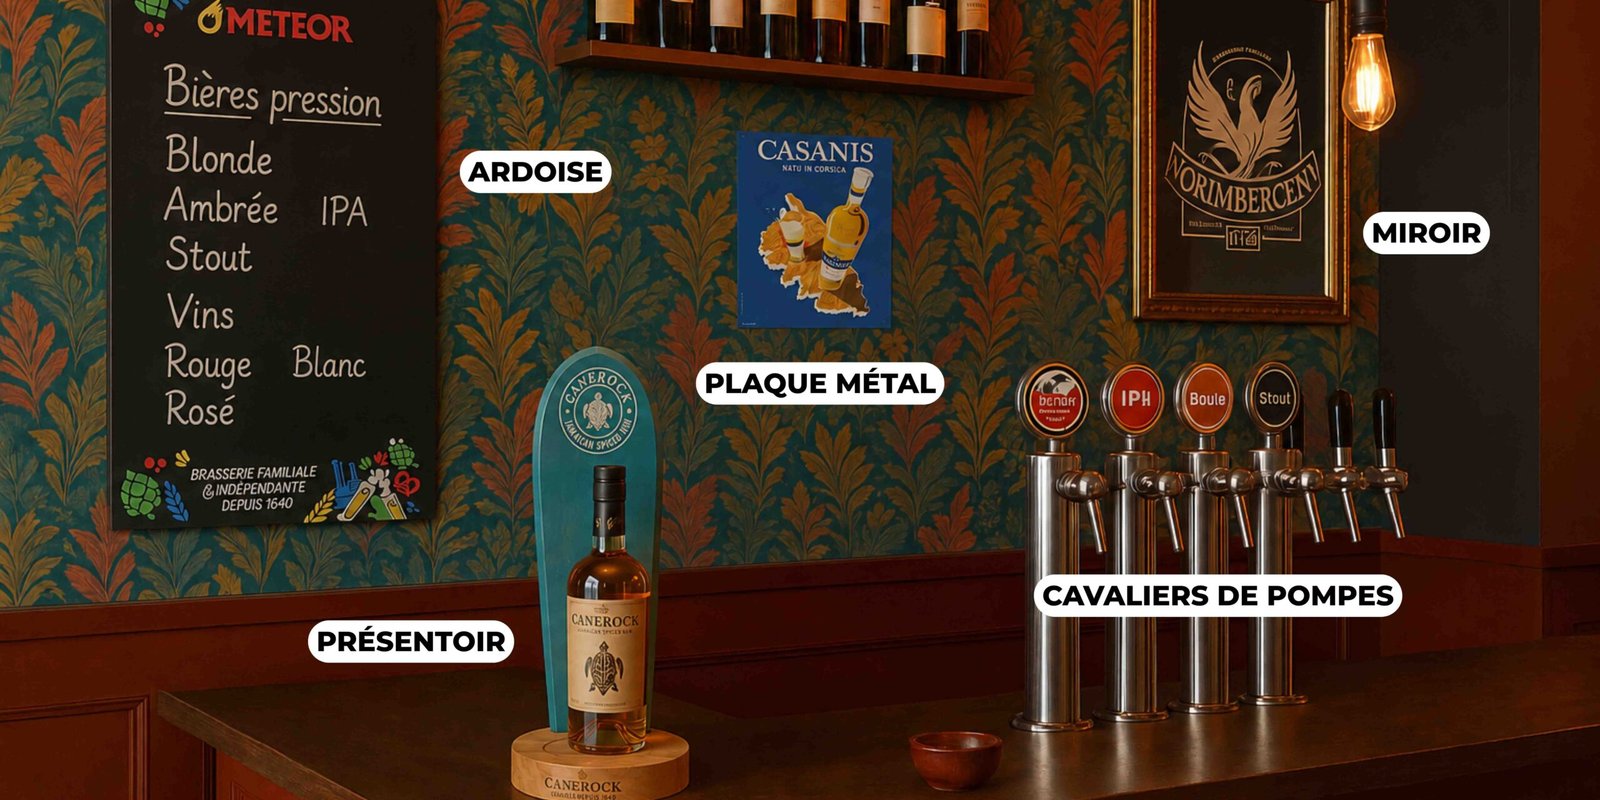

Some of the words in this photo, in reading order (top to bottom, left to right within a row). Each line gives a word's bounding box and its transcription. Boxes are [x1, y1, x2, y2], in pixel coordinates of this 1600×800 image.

[226, 7, 353, 43] METEOR
[164, 63, 259, 110] Bières
[269, 86, 382, 124] pression
[166, 133, 272, 175] Blonde
[758, 139, 874, 163] CASANIS
[164, 186, 278, 224] Ambrée
[322, 195, 368, 227] IPA
[166, 235, 252, 272] Stout
[167, 292, 234, 330] Vins
[165, 342, 252, 390] Rouge
[292, 344, 367, 378] Blanc
[565, 371, 632, 404] CANEROCK
[1189, 391, 1226, 406] Boule
[1259, 390, 1291, 406] Stout
[165, 389, 235, 425] Rosé
[190, 467, 255, 481] BRASSERIE
[257, 465, 318, 479] FAMILIALE
[222, 498, 262, 512] DEPUIS
[265, 496, 294, 510] 1640
[571, 613, 639, 627] CANEROCK
[544, 777, 622, 792] CANEROCK
